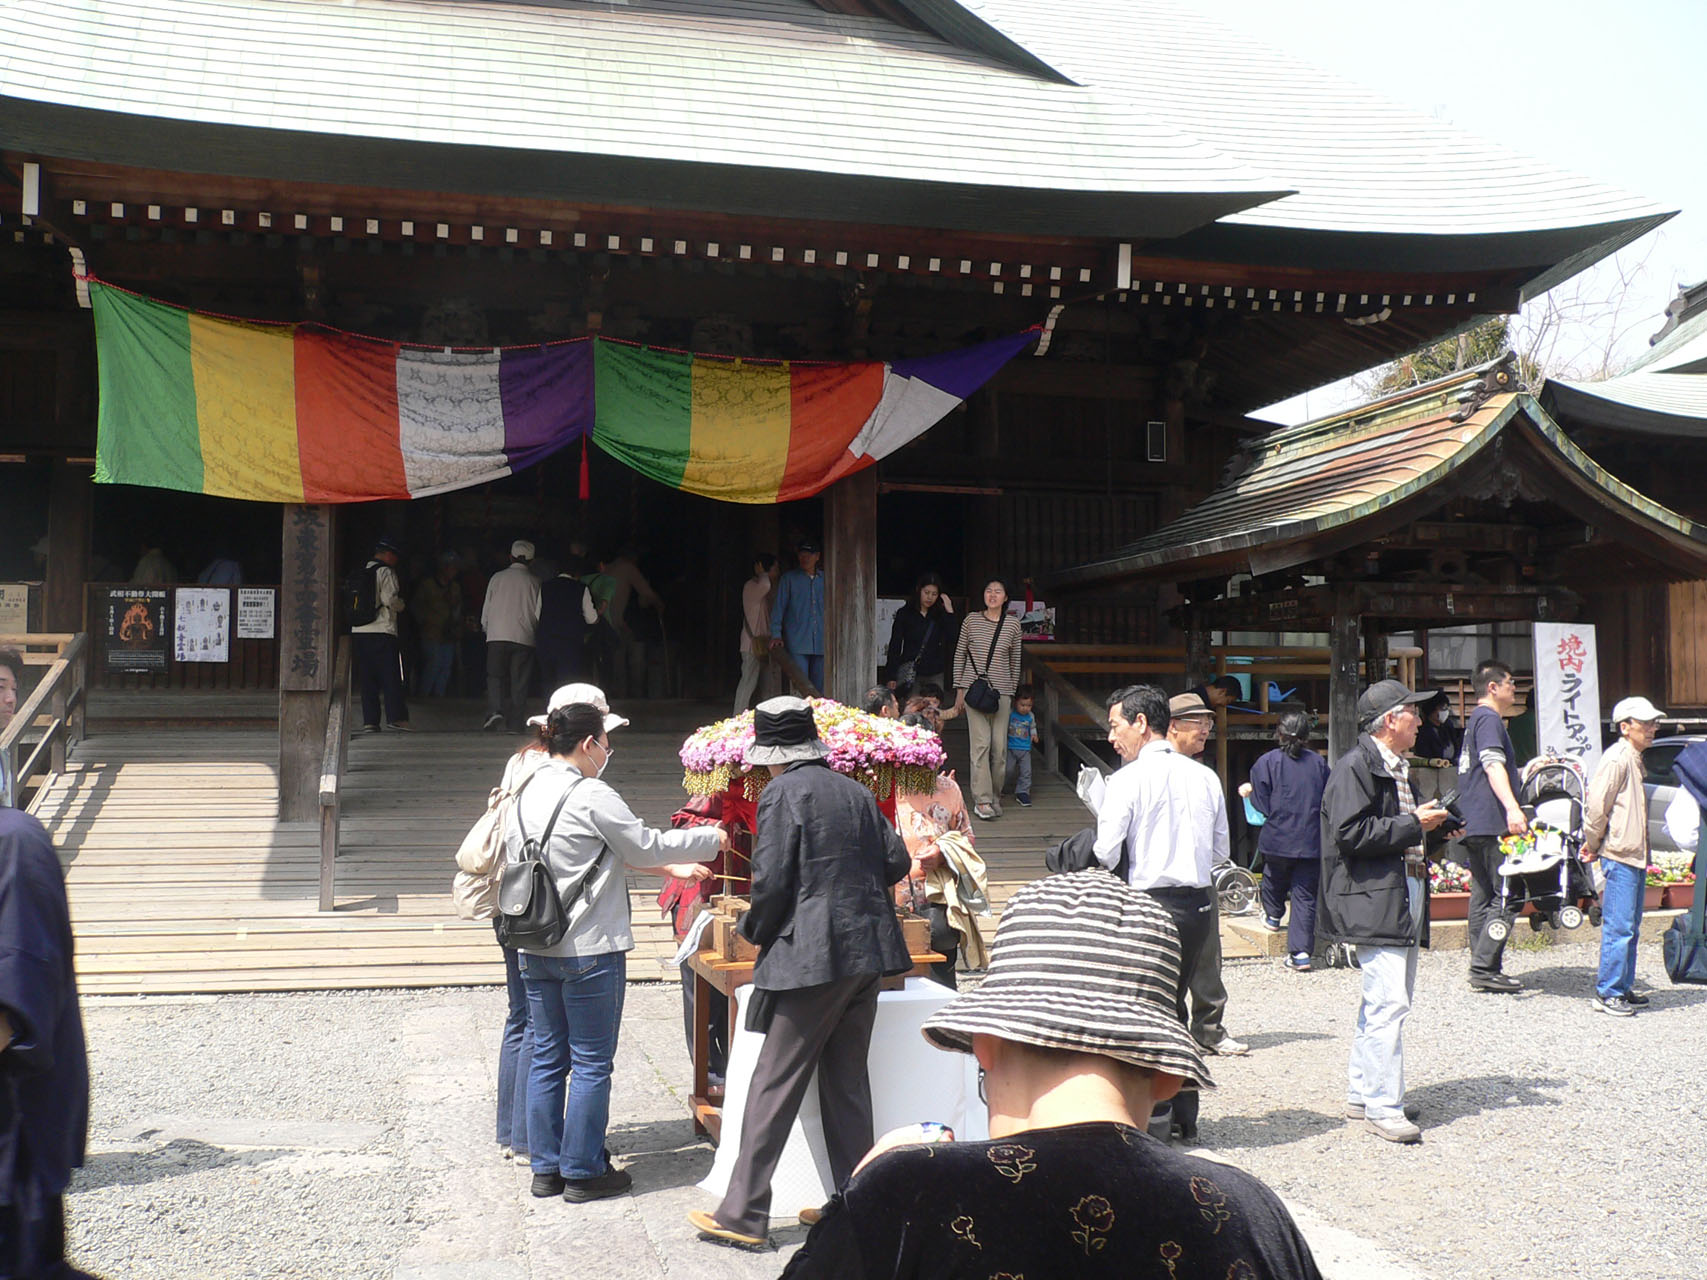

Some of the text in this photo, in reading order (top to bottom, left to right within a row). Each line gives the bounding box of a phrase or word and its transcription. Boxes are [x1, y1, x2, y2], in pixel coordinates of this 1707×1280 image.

[1557, 633, 1592, 757] 境内ライトアップ
